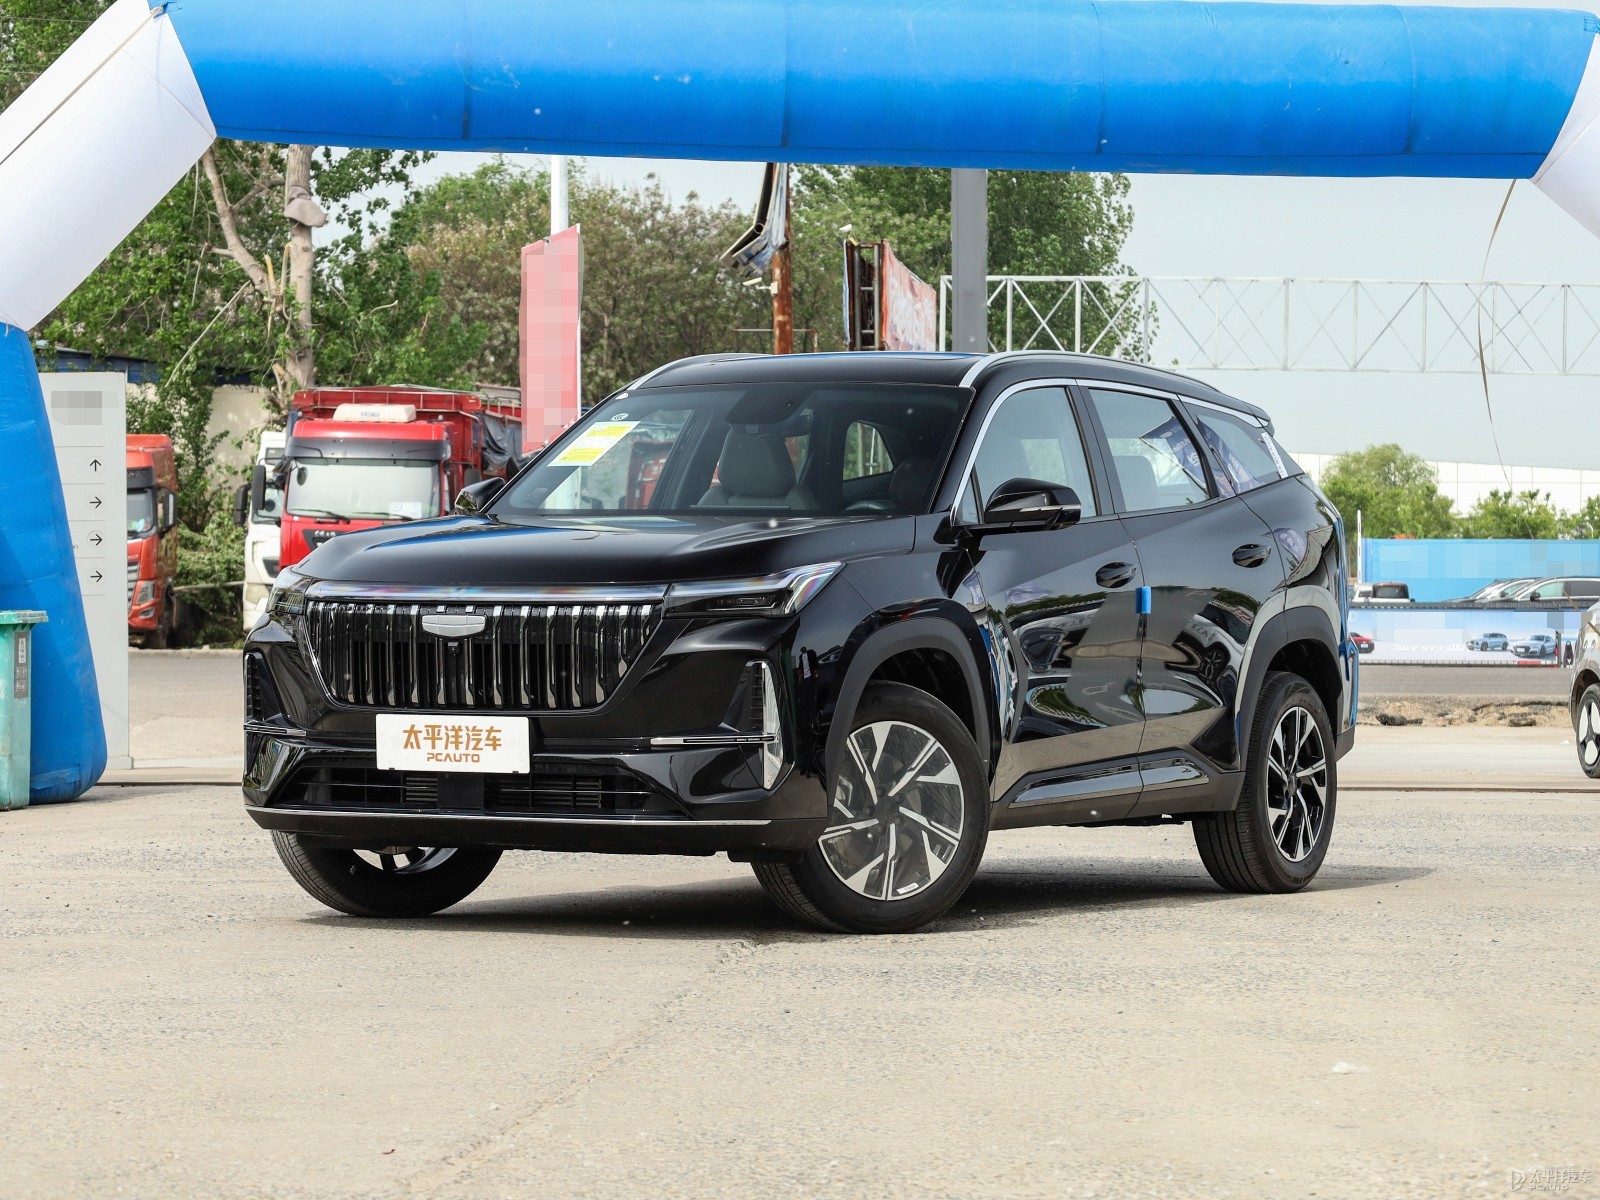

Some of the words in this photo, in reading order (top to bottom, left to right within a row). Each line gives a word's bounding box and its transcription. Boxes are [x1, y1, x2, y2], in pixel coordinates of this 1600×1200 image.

[402, 724, 502, 751] 太平洋汽车
[426, 752, 480, 763] PCAUTO
